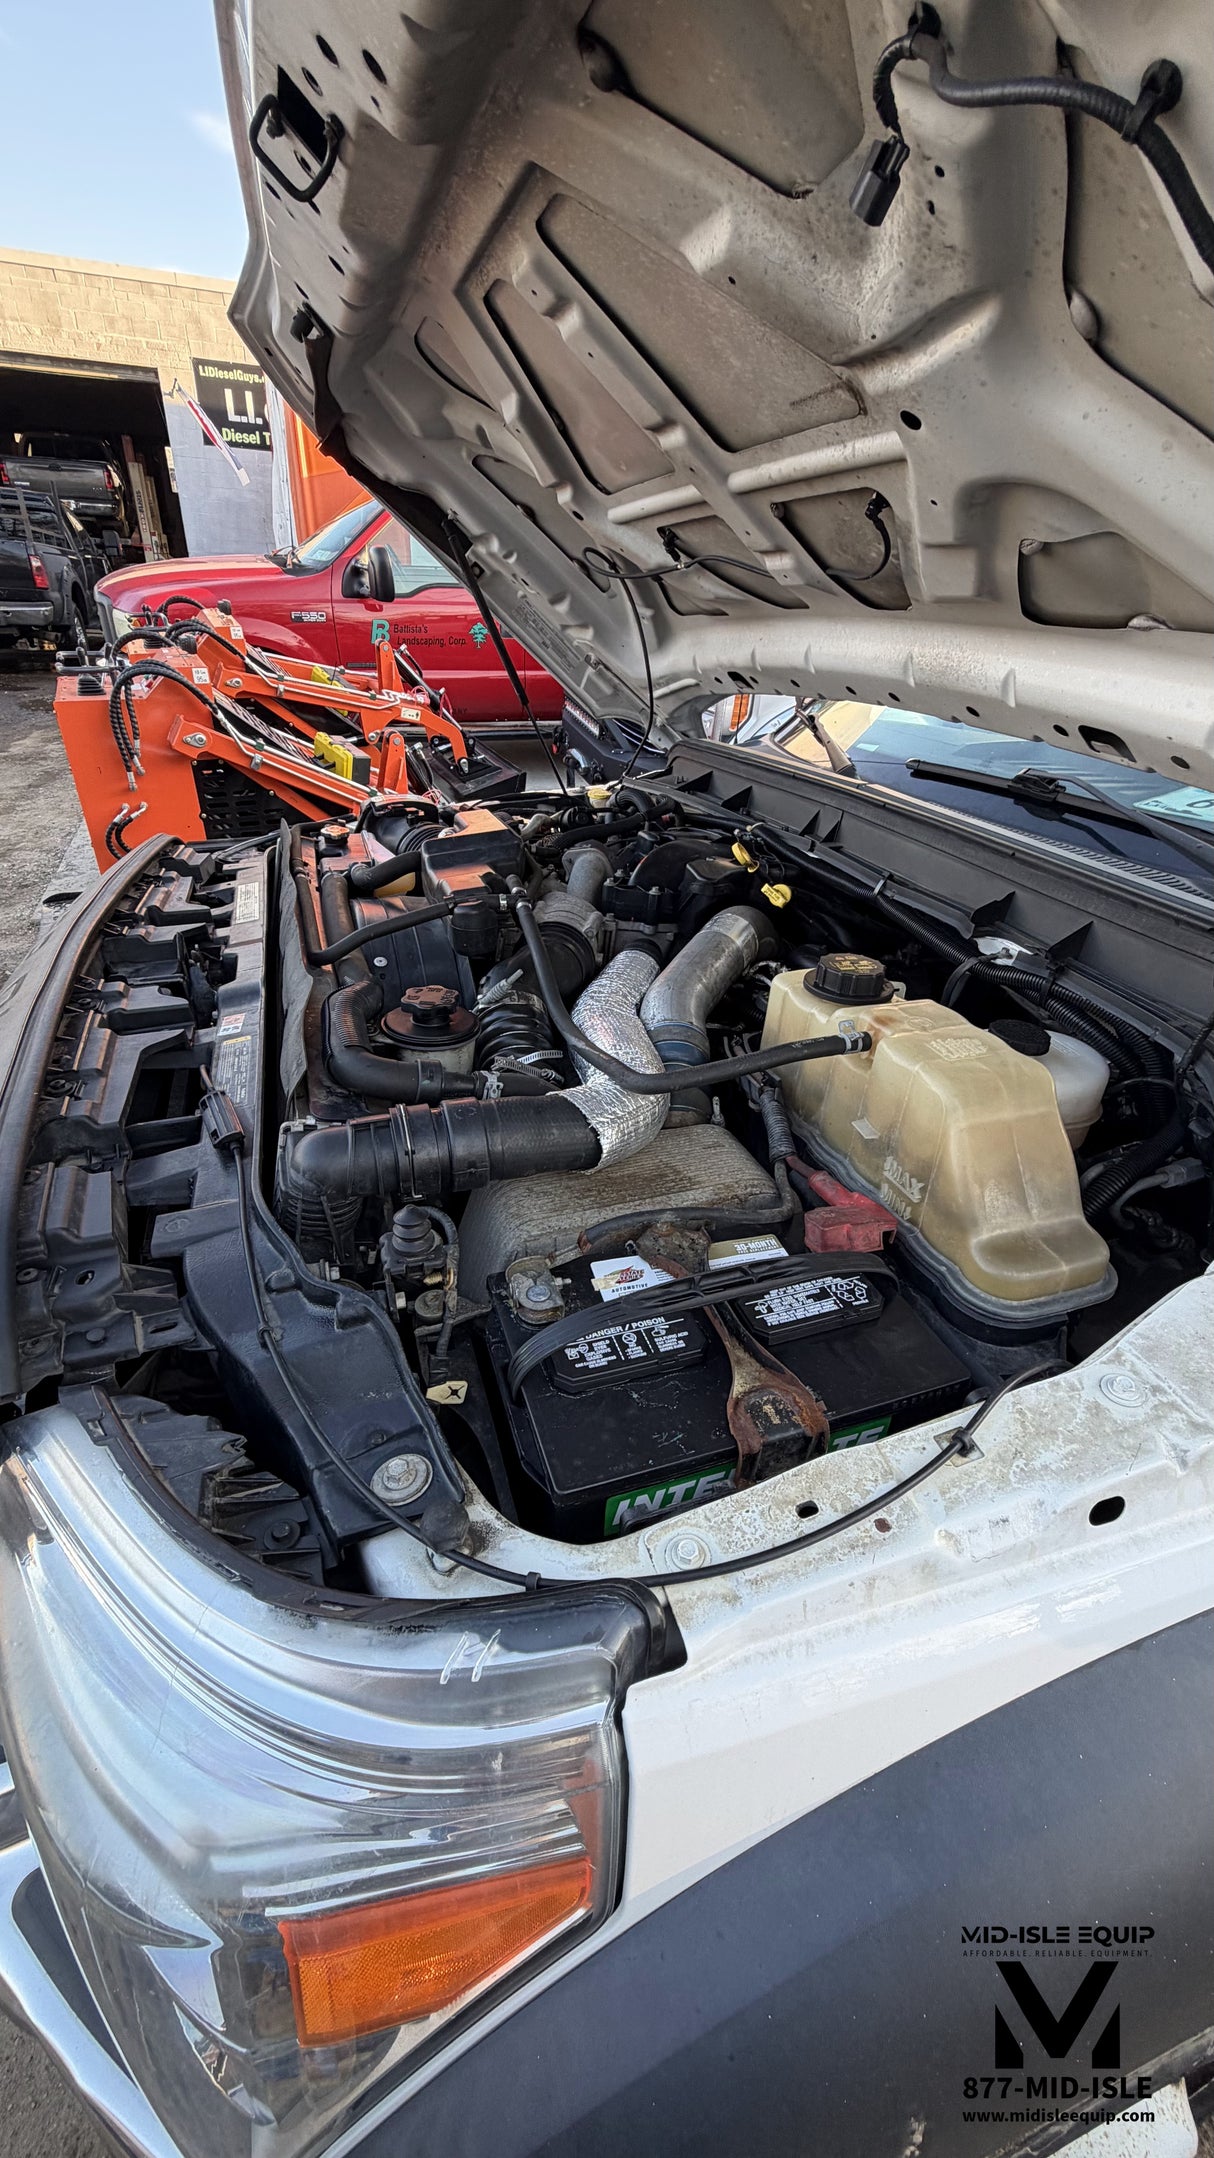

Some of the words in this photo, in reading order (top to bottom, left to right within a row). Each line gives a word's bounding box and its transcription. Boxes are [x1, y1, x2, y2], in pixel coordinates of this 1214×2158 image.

[221, 427, 261, 445] Diesel
[291, 611, 327, 620] F-550
[393, 623, 428, 634] Battista's
[397, 635, 446, 648] Landscaping,
[611, 1283, 648, 1293] AUTOMOTIVE
[631, 1316, 666, 1329] POISON
